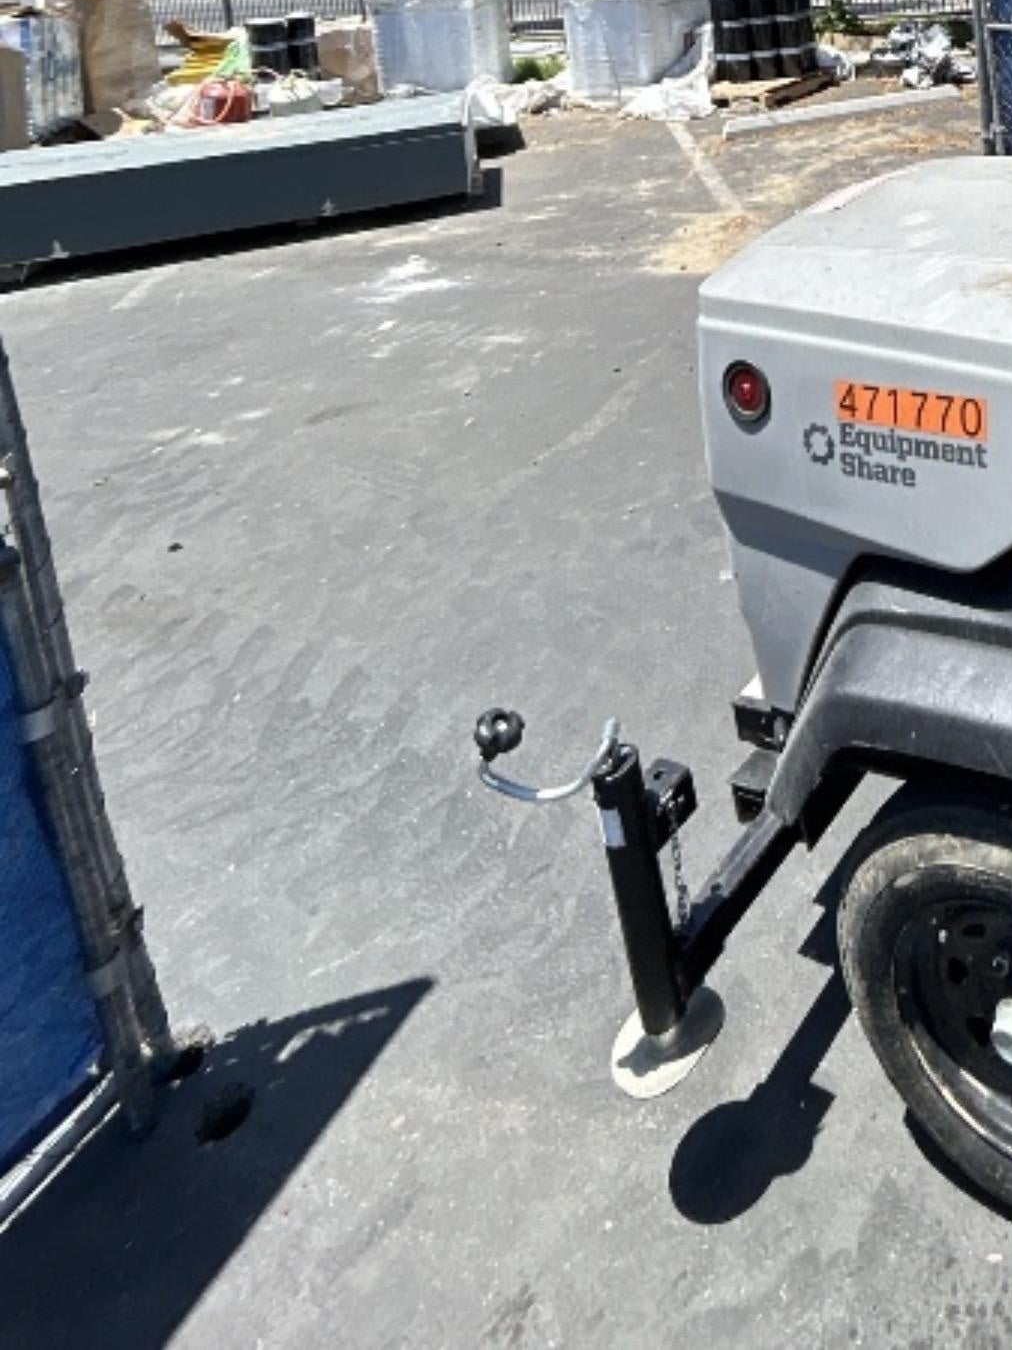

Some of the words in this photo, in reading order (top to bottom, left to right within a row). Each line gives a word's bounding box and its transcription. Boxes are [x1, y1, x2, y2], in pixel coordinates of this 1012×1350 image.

[839, 384, 982, 437] 471770
[839, 422, 988, 468] Equipment
[839, 451, 916, 487] Share
